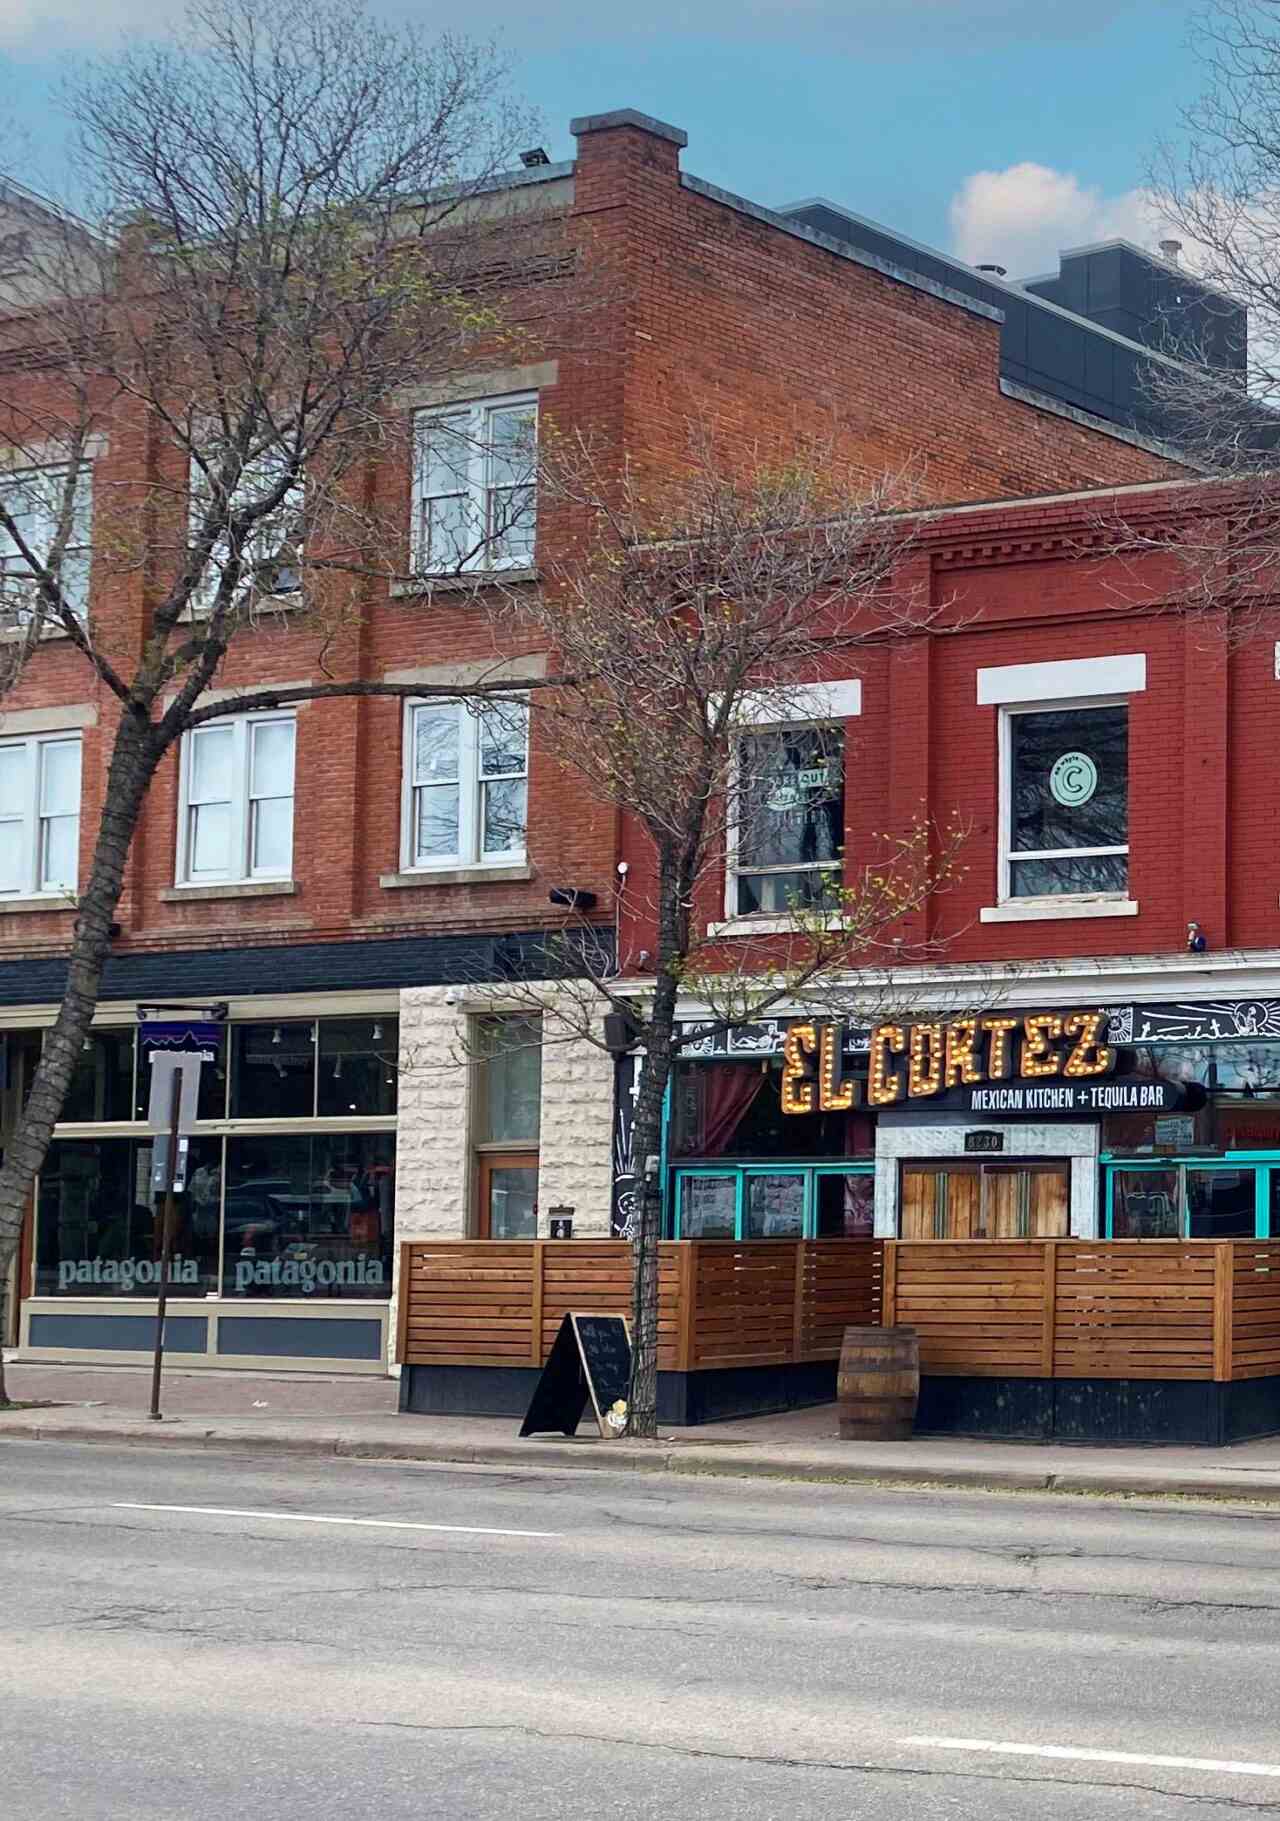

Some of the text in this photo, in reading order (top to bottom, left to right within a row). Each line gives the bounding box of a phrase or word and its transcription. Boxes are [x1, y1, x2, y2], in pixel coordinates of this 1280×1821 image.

[800, 773, 825, 784] OUT
[1063, 765, 1083, 793] C
[782, 1013, 1111, 1114] EL CORTEZ
[971, 1089, 1024, 1110] MEXICAN
[1026, 1087, 1074, 1109] KITCHEN
[1091, 1086, 1138, 1108] TEQUILA
[1140, 1086, 1164, 1106] BAR
[58, 1254, 199, 1290] patagonia
[235, 1253, 385, 1292] patagonia
